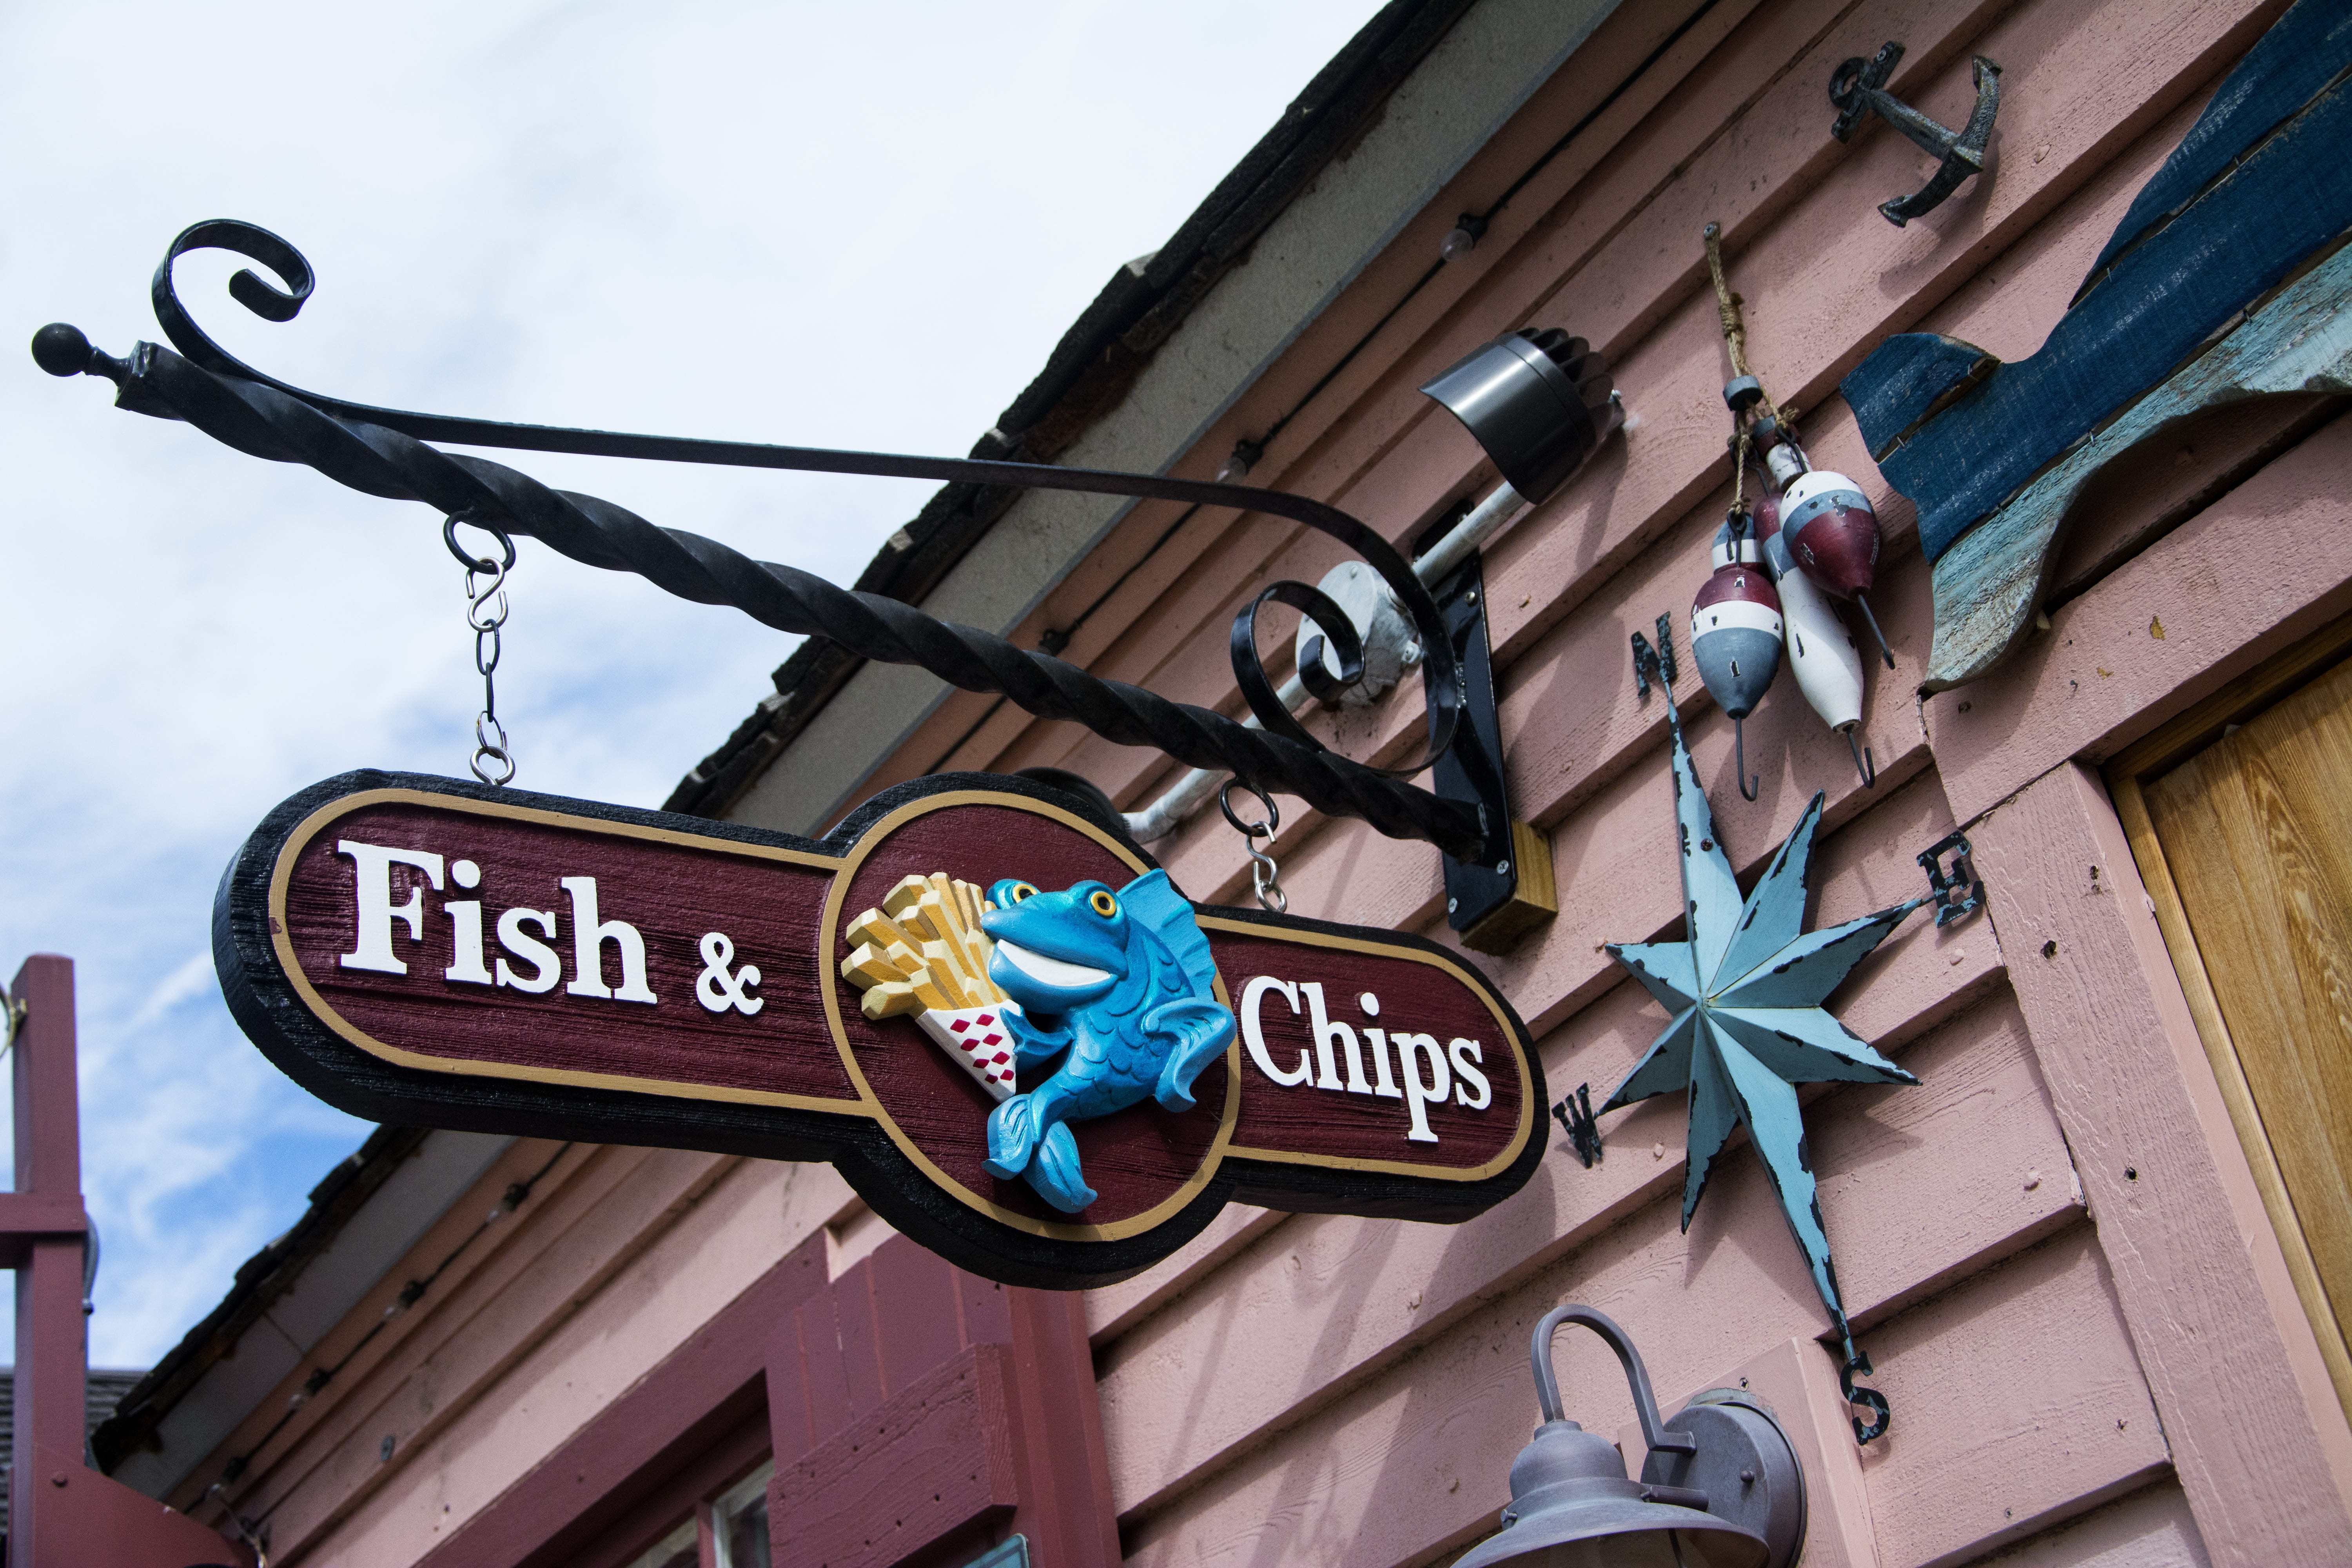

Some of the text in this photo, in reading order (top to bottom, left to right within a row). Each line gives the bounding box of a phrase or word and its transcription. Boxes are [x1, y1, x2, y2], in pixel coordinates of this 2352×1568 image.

[1631, 611, 1677, 698] N
[1916, 829, 1984, 928] E
[337, 839, 1492, 1142] Fish & Chips
[1552, 1082, 1603, 1169] W
[1840, 1351, 1890, 1446] S
